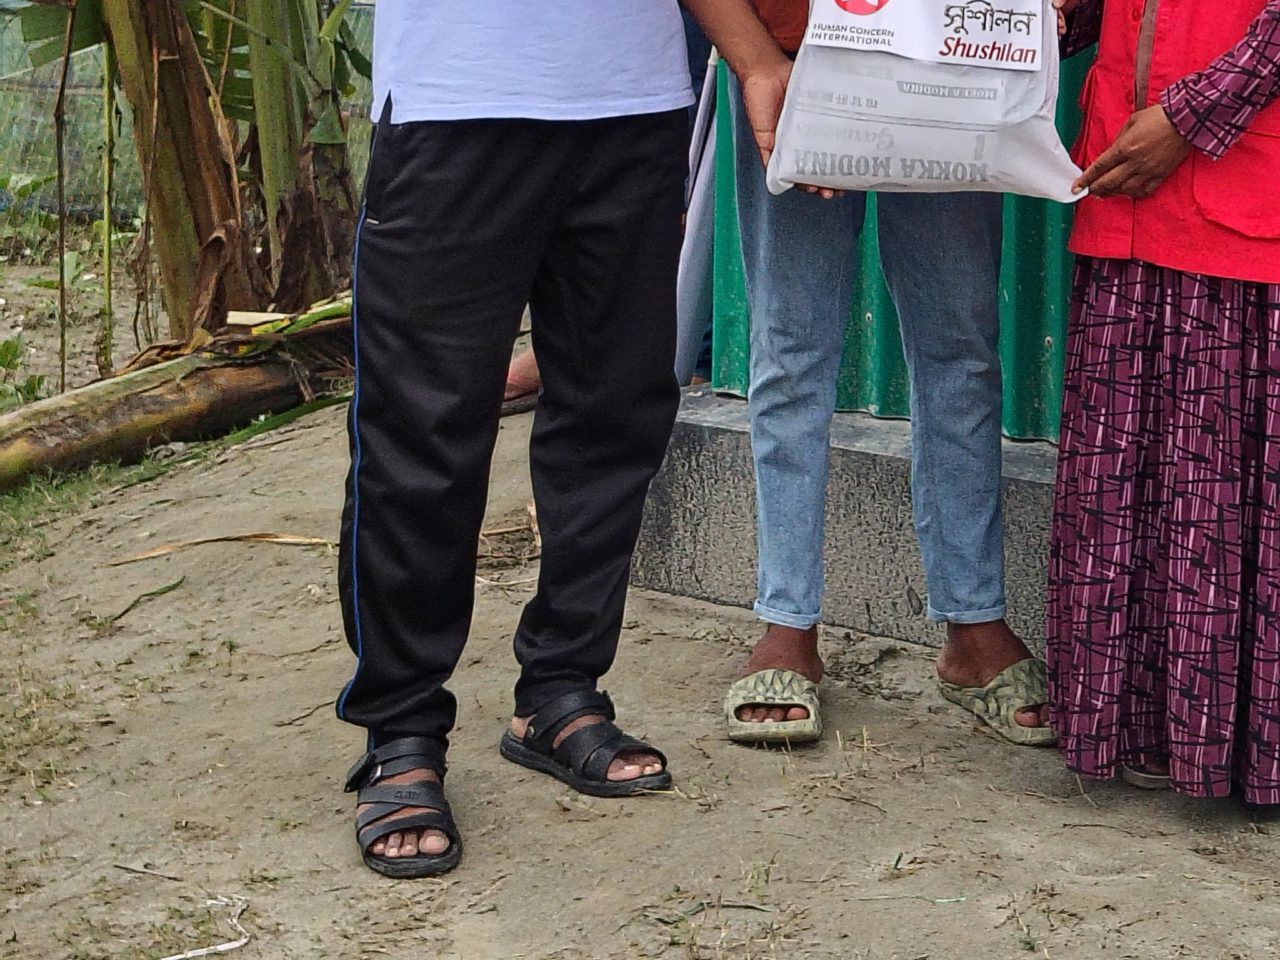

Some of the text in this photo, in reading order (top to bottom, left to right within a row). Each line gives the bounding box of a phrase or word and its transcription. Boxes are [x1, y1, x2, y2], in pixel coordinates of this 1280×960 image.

[813, 23, 895, 38] HUMAN CONCERN
[811, 32, 893, 47] INTERNATIONAL
[939, 36, 1037, 64] Shushilan
